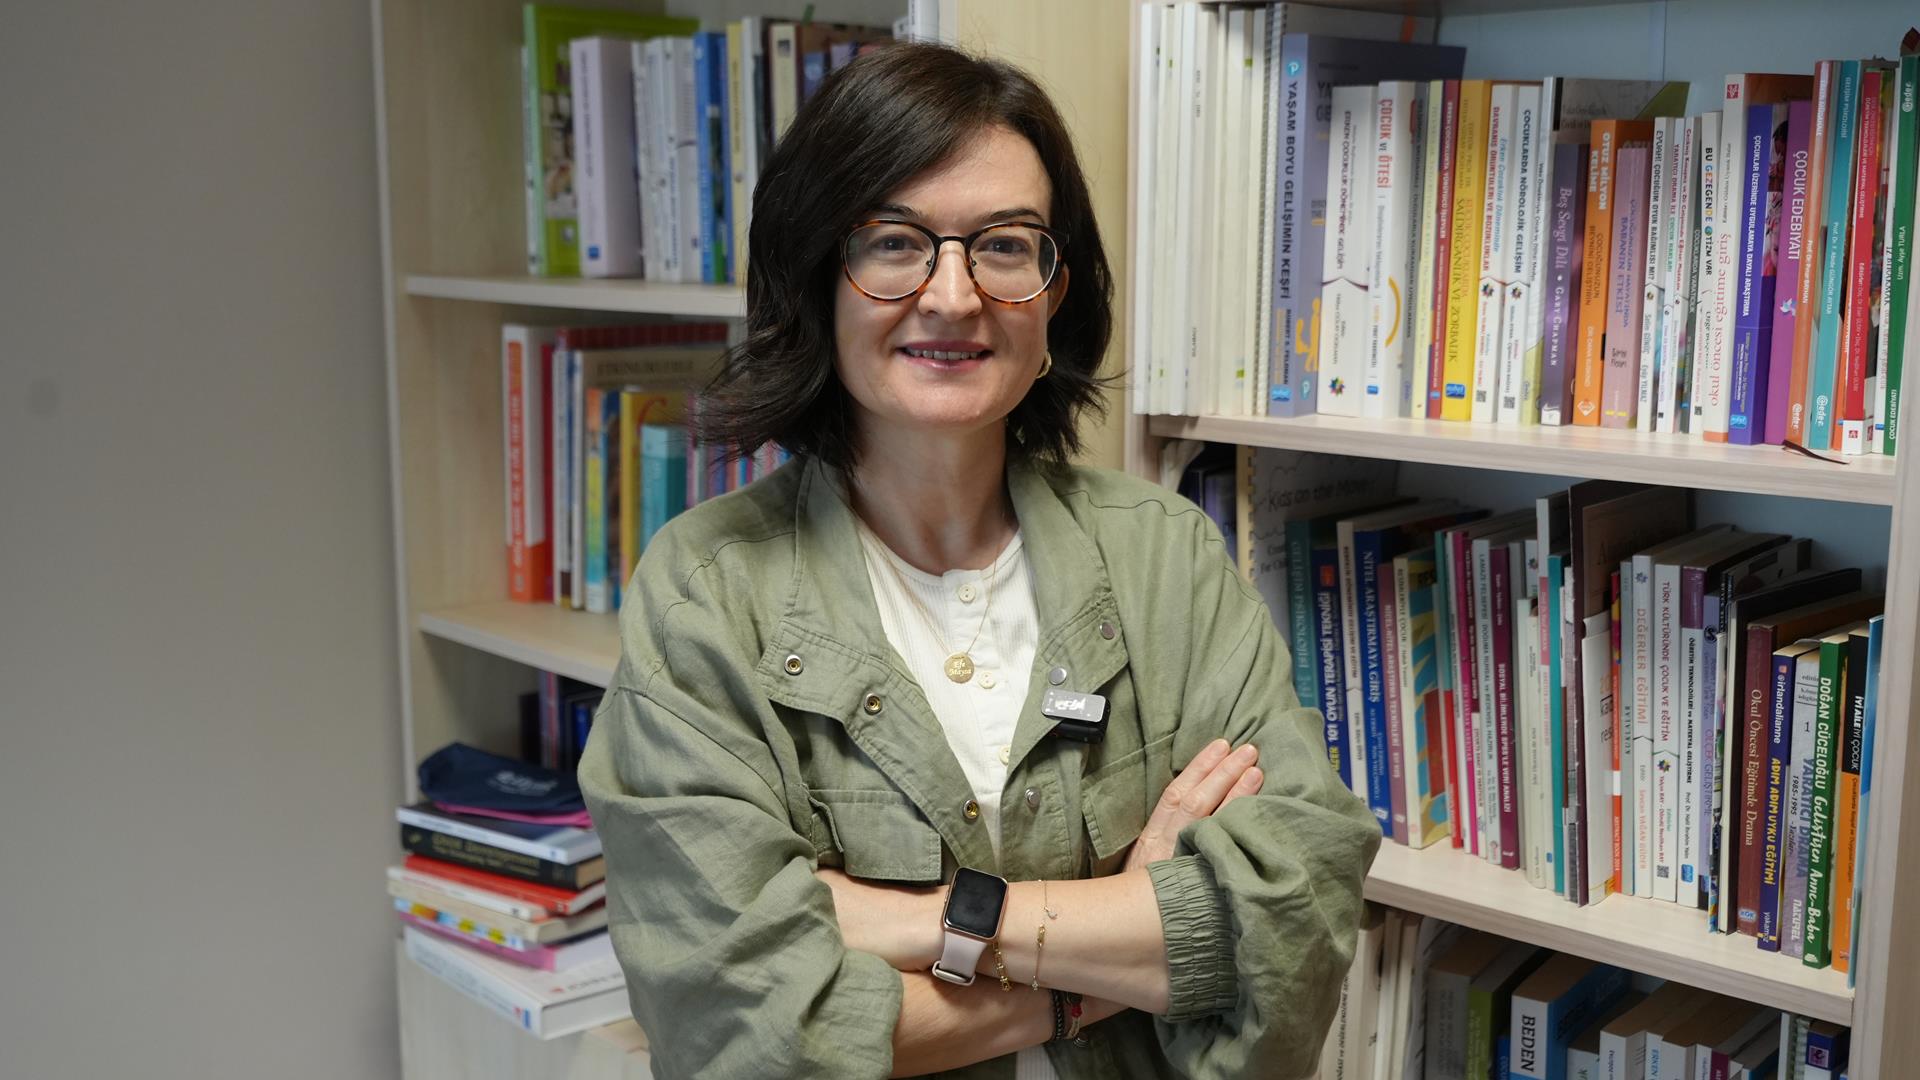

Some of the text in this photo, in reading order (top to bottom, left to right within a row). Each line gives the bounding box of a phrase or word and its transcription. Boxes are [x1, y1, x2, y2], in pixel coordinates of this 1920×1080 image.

[1376, 98, 1394, 140] ÇOCUK
[1376, 154, 1392, 189] ÖTESİ
[1589, 150, 1600, 194] KELİME
[1598, 131, 1611, 211] OTUZ MİLYON
[1706, 147, 1714, 162] BU
[1793, 150, 1809, 195] ÇOCUK
[1279, 81, 1298, 299] YAŞAM BOYU GELİŞİMİN KEŞFİ
[1513, 109, 1531, 273] ÇOCUKLARDA NÖROLOJİK GELİŞİM
[1652, 164, 1663, 202] ÇOCUĞUM
[1705, 165, 1713, 222] GEZEGENDE
[1454, 198, 1465, 285] SALDIRGANLIK
[1552, 211, 1570, 242] Sevgi
[1651, 204, 1660, 225] OYUN
[1742, 135, 1761, 317] ÇOCUKLAR ÜZERİNDE UYGULAMAYA DAYALI ARAŞTIRMA
[1618, 216, 1628, 270] BABANIN
[1705, 260, 1713, 276] VAR
[1452, 289, 1462, 302] VE
[1709, 375, 1721, 406] okul
[1716, 233, 1731, 265] giriş
[1448, 306, 1461, 362] ZORBALIK
[1550, 286, 1565, 367] GARY CHAPMAN
[1889, 419, 1897, 440] ÇOCUK
[1318, 592, 1333, 637] TEKNİĞİ
[1363, 550, 1382, 703] NİTEL ARAŞTIRMAYA GİRİŞ
[1320, 638, 1335, 685] TERAPİSİ
[1637, 608, 1649, 724] DEĞERLER EĞİTİMİ
[1660, 582, 1672, 741] TÜRK KÜLTÜRÜNDE ÇOCUK VE EĞİTİM
[1688, 637, 1696, 665] ÖĞRETİM
[1325, 687, 1337, 721] OYUN
[1687, 666, 1695, 710] TEKNOLOJİLERİ
[1773, 674, 1787, 744] @irlandalianne
[1818, 677, 1833, 719] DOĞAN
[1327, 724, 1338, 743] 101
[1498, 663, 1512, 813] SOSYAL BİLİMLERDE SPSS'LE VERİ ANALİZİ
[1815, 722, 1830, 789] CÜCELOĞLU
[1851, 695, 1864, 770] İYİ AİLE İYİ ÇOCUK
[1685, 751, 1693, 784] GELİŞTİRME
[1745, 690, 1764, 846] Okul Öncesi Eğitimde Drama
[1764, 757, 1781, 885] ADIM ADIM UYKU EĞİTİMİ
[1790, 775, 1800, 816] 1985-1995
[1796, 758, 1815, 878] YARATICI DRAMA
[1807, 868, 1822, 944] Anne-Baba
[1521, 1014, 1537, 1073] BEDEN
[1651, 1048, 1661, 1077] ERKEN
